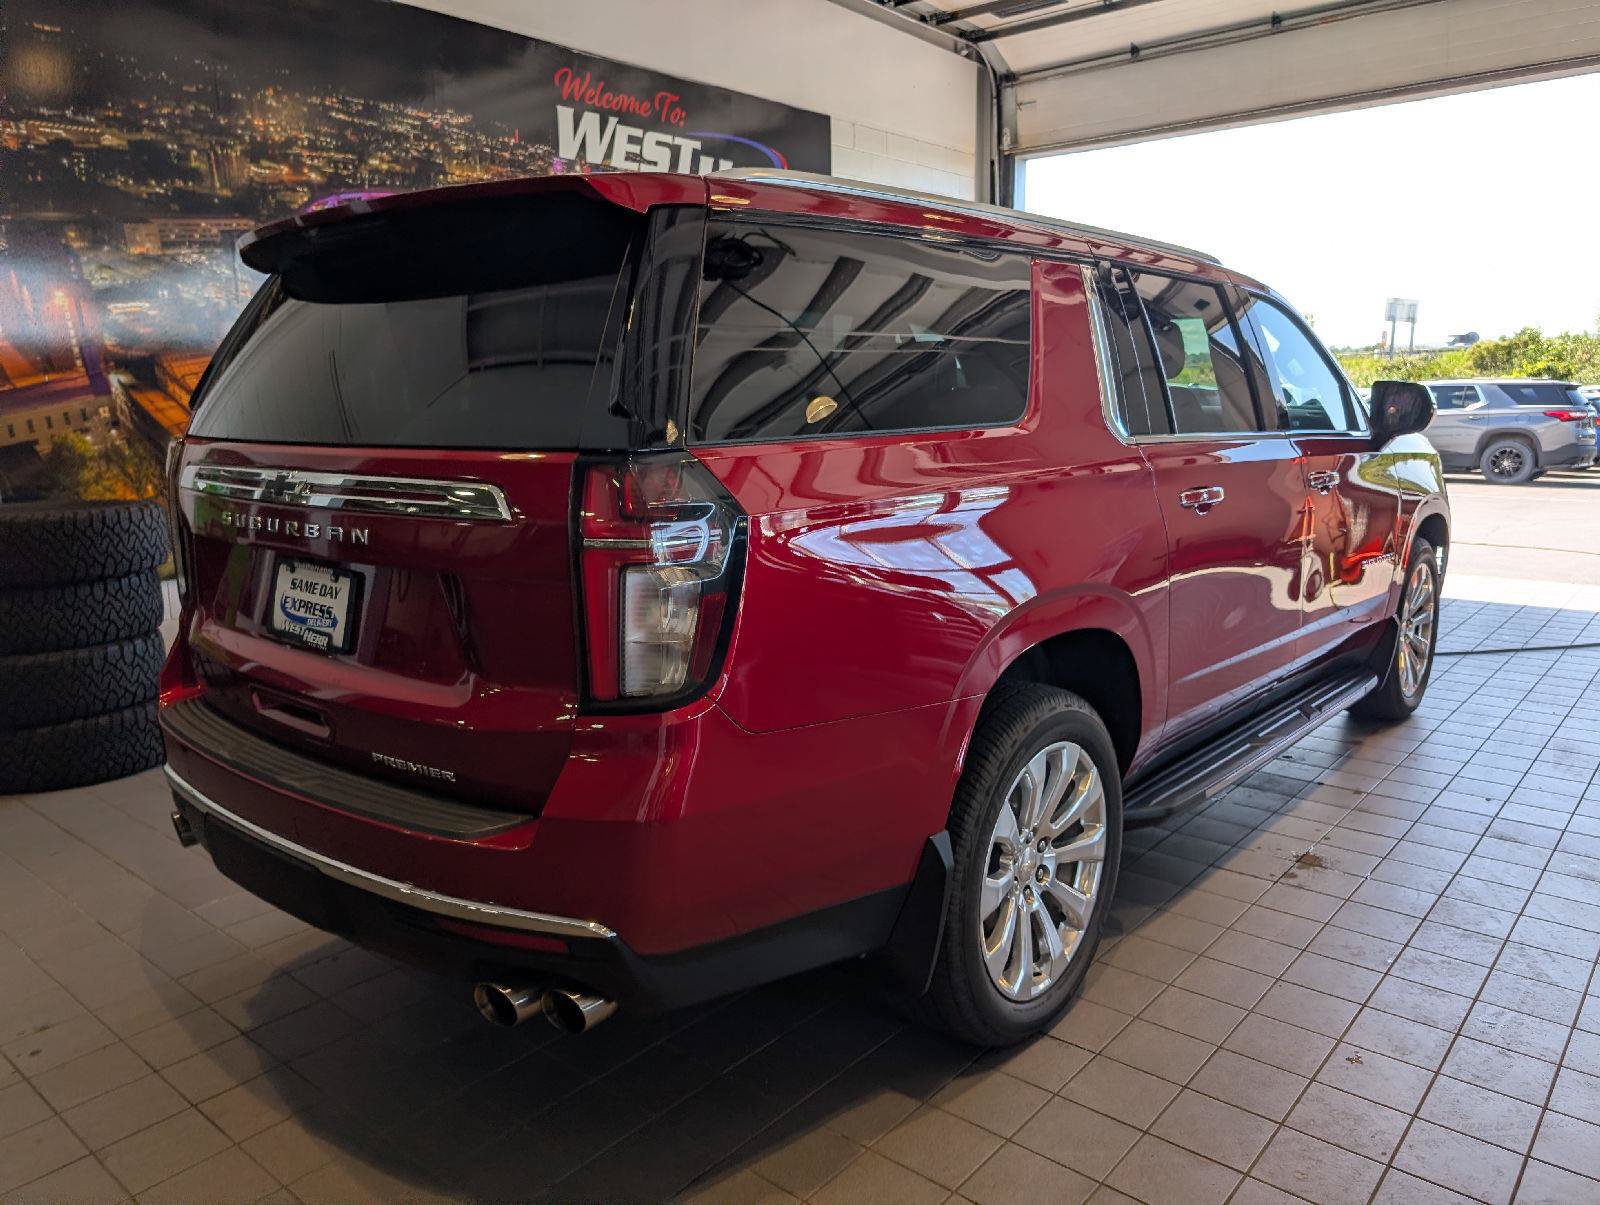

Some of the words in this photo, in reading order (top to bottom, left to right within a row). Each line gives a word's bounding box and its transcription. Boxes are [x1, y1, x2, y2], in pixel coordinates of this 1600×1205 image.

[554, 67, 652, 117] Welcome
[654, 91, 687, 128] To:
[556, 105, 702, 173] WEST
[221, 511, 369, 546] SUBURBAN
[290, 578, 320, 596] SAME
[318, 583, 342, 600] DAY
[283, 595, 334, 620] EXPRESS
[372, 752, 456, 782] PREMIER
